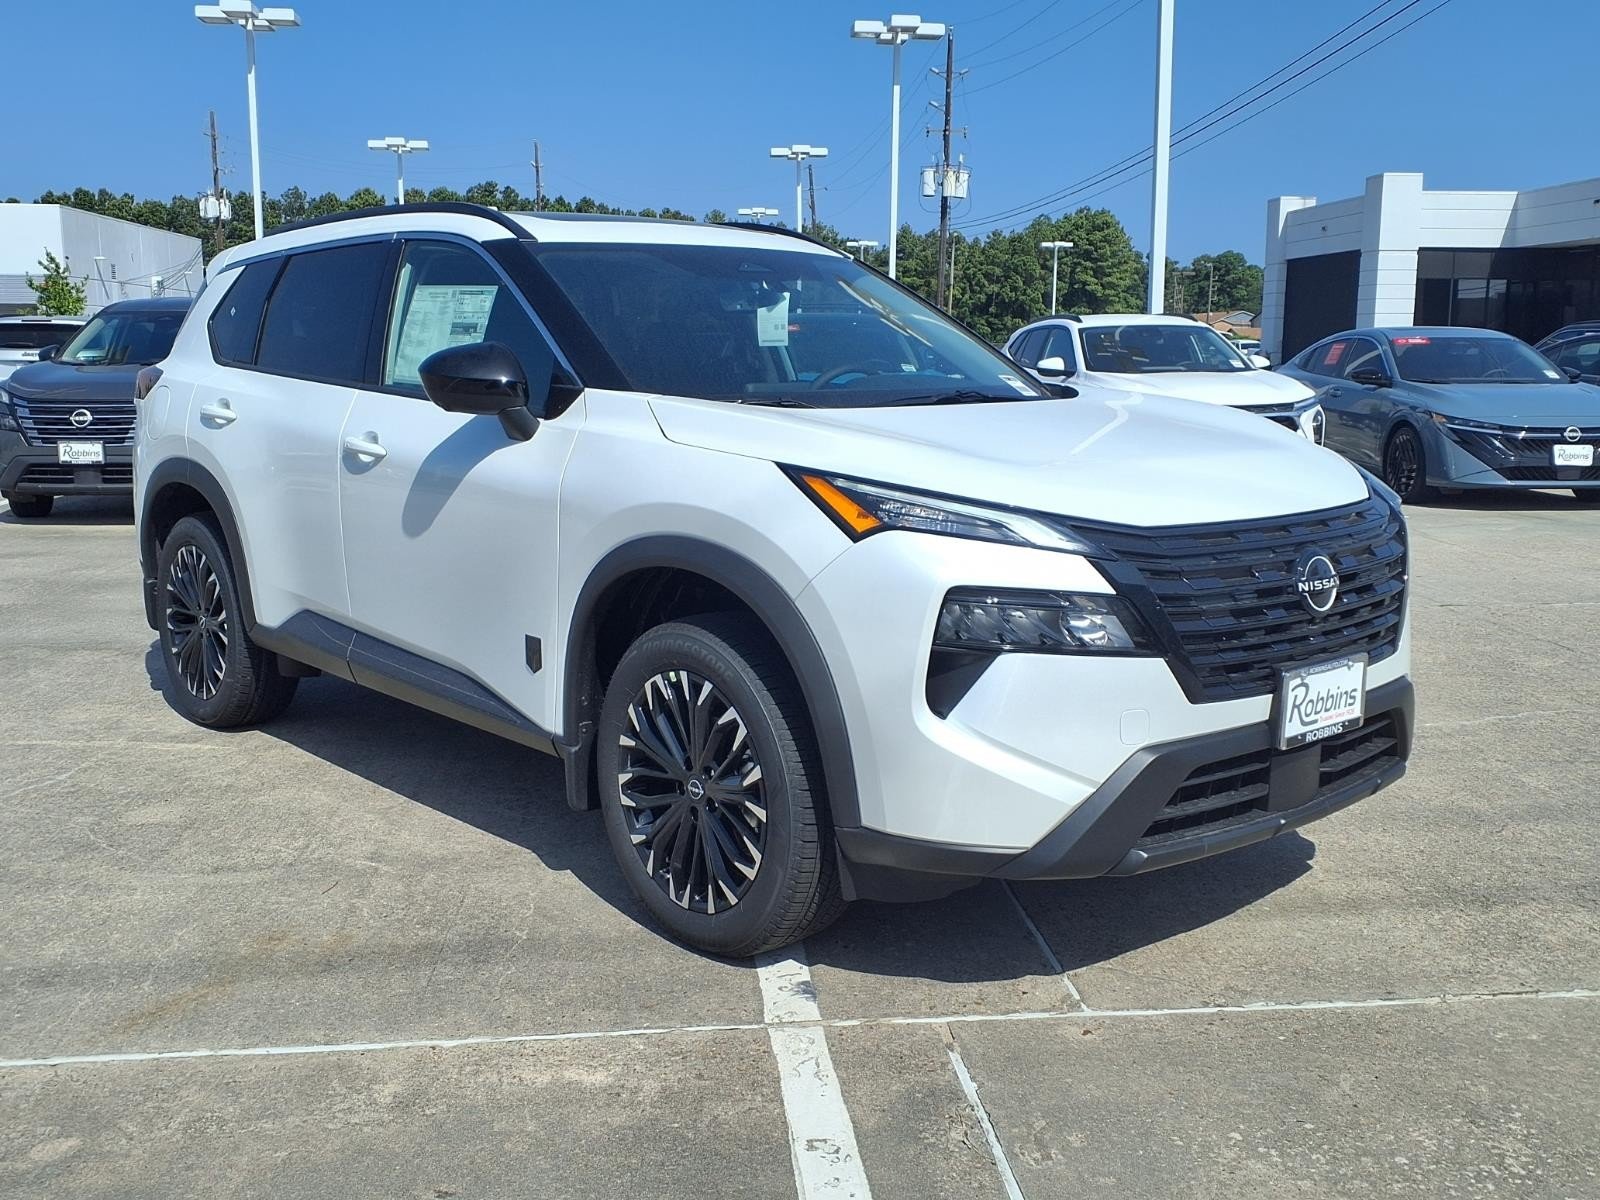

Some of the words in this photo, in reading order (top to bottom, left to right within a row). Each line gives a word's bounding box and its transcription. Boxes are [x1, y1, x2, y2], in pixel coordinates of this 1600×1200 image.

[63, 445, 100, 459] Robbins
[1558, 448, 1590, 461] Robbins
[1297, 575, 1339, 592] NISSAN
[1288, 681, 1358, 727] Robbins
[1305, 724, 1343, 742] ROBBINS
